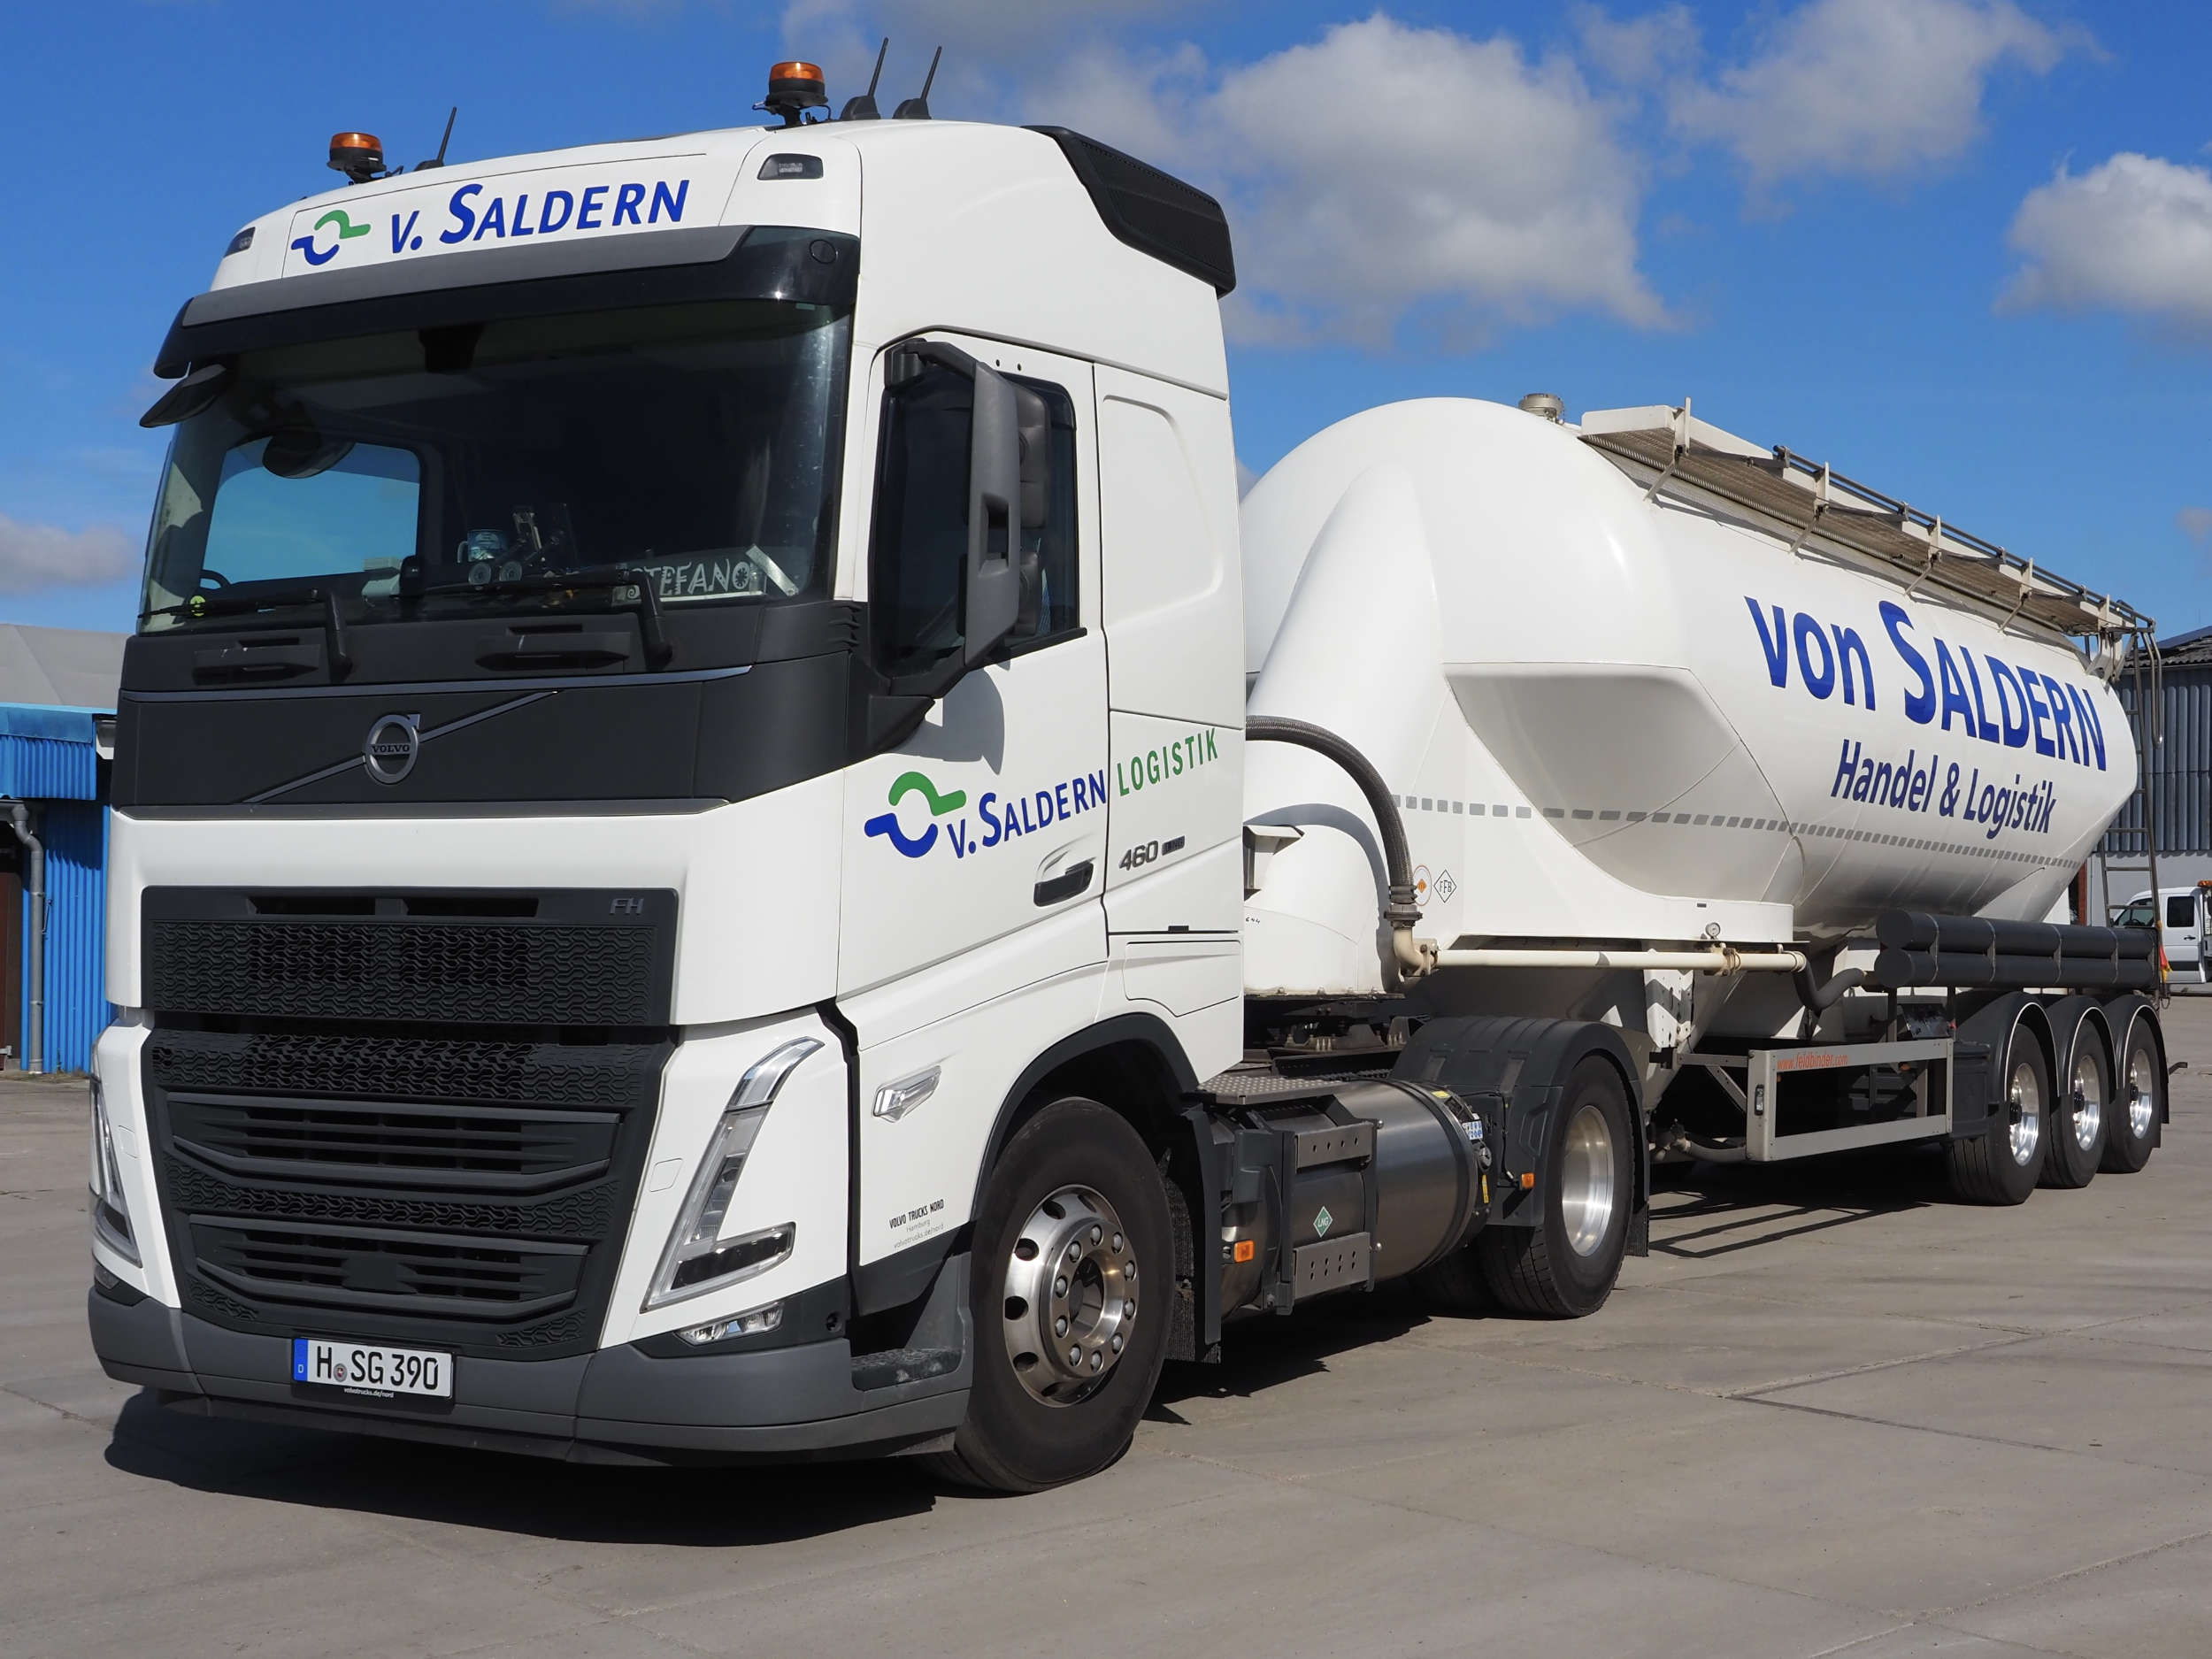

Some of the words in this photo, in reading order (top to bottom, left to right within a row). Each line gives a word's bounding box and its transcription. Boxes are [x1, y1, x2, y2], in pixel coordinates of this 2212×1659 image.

[439, 180, 690, 244] SALDERN
[1744, 595, 1876, 711] von
[1878, 600, 2107, 772] SALDERN
[372, 744, 410, 753] VOLVO
[979, 769, 1107, 848] SALDERN
[1117, 727, 1218, 796] LOGISTIK
[1831, 739, 1938, 813] Handel
[1939, 762, 1961, 818] &
[1963, 768, 2057, 839] Logistik
[1118, 840, 1159, 872] 460
[609, 898, 644, 914] FH
[1778, 1051, 1848, 1070] www.feldbinder.com
[888, 1213, 907, 1229] VOLVO
[908, 1205, 928, 1222] TRUCKS
[929, 1198, 944, 1214] NORD
[1317, 1216, 1329, 1228] LNG
[297, 1363, 305, 1374] D
[317, 1345, 333, 1379] H
[350, 1349, 384, 1385] SG
[390, 1354, 439, 1390] 390
[343, 1386, 395, 1398] volvotrucks.de/nord
